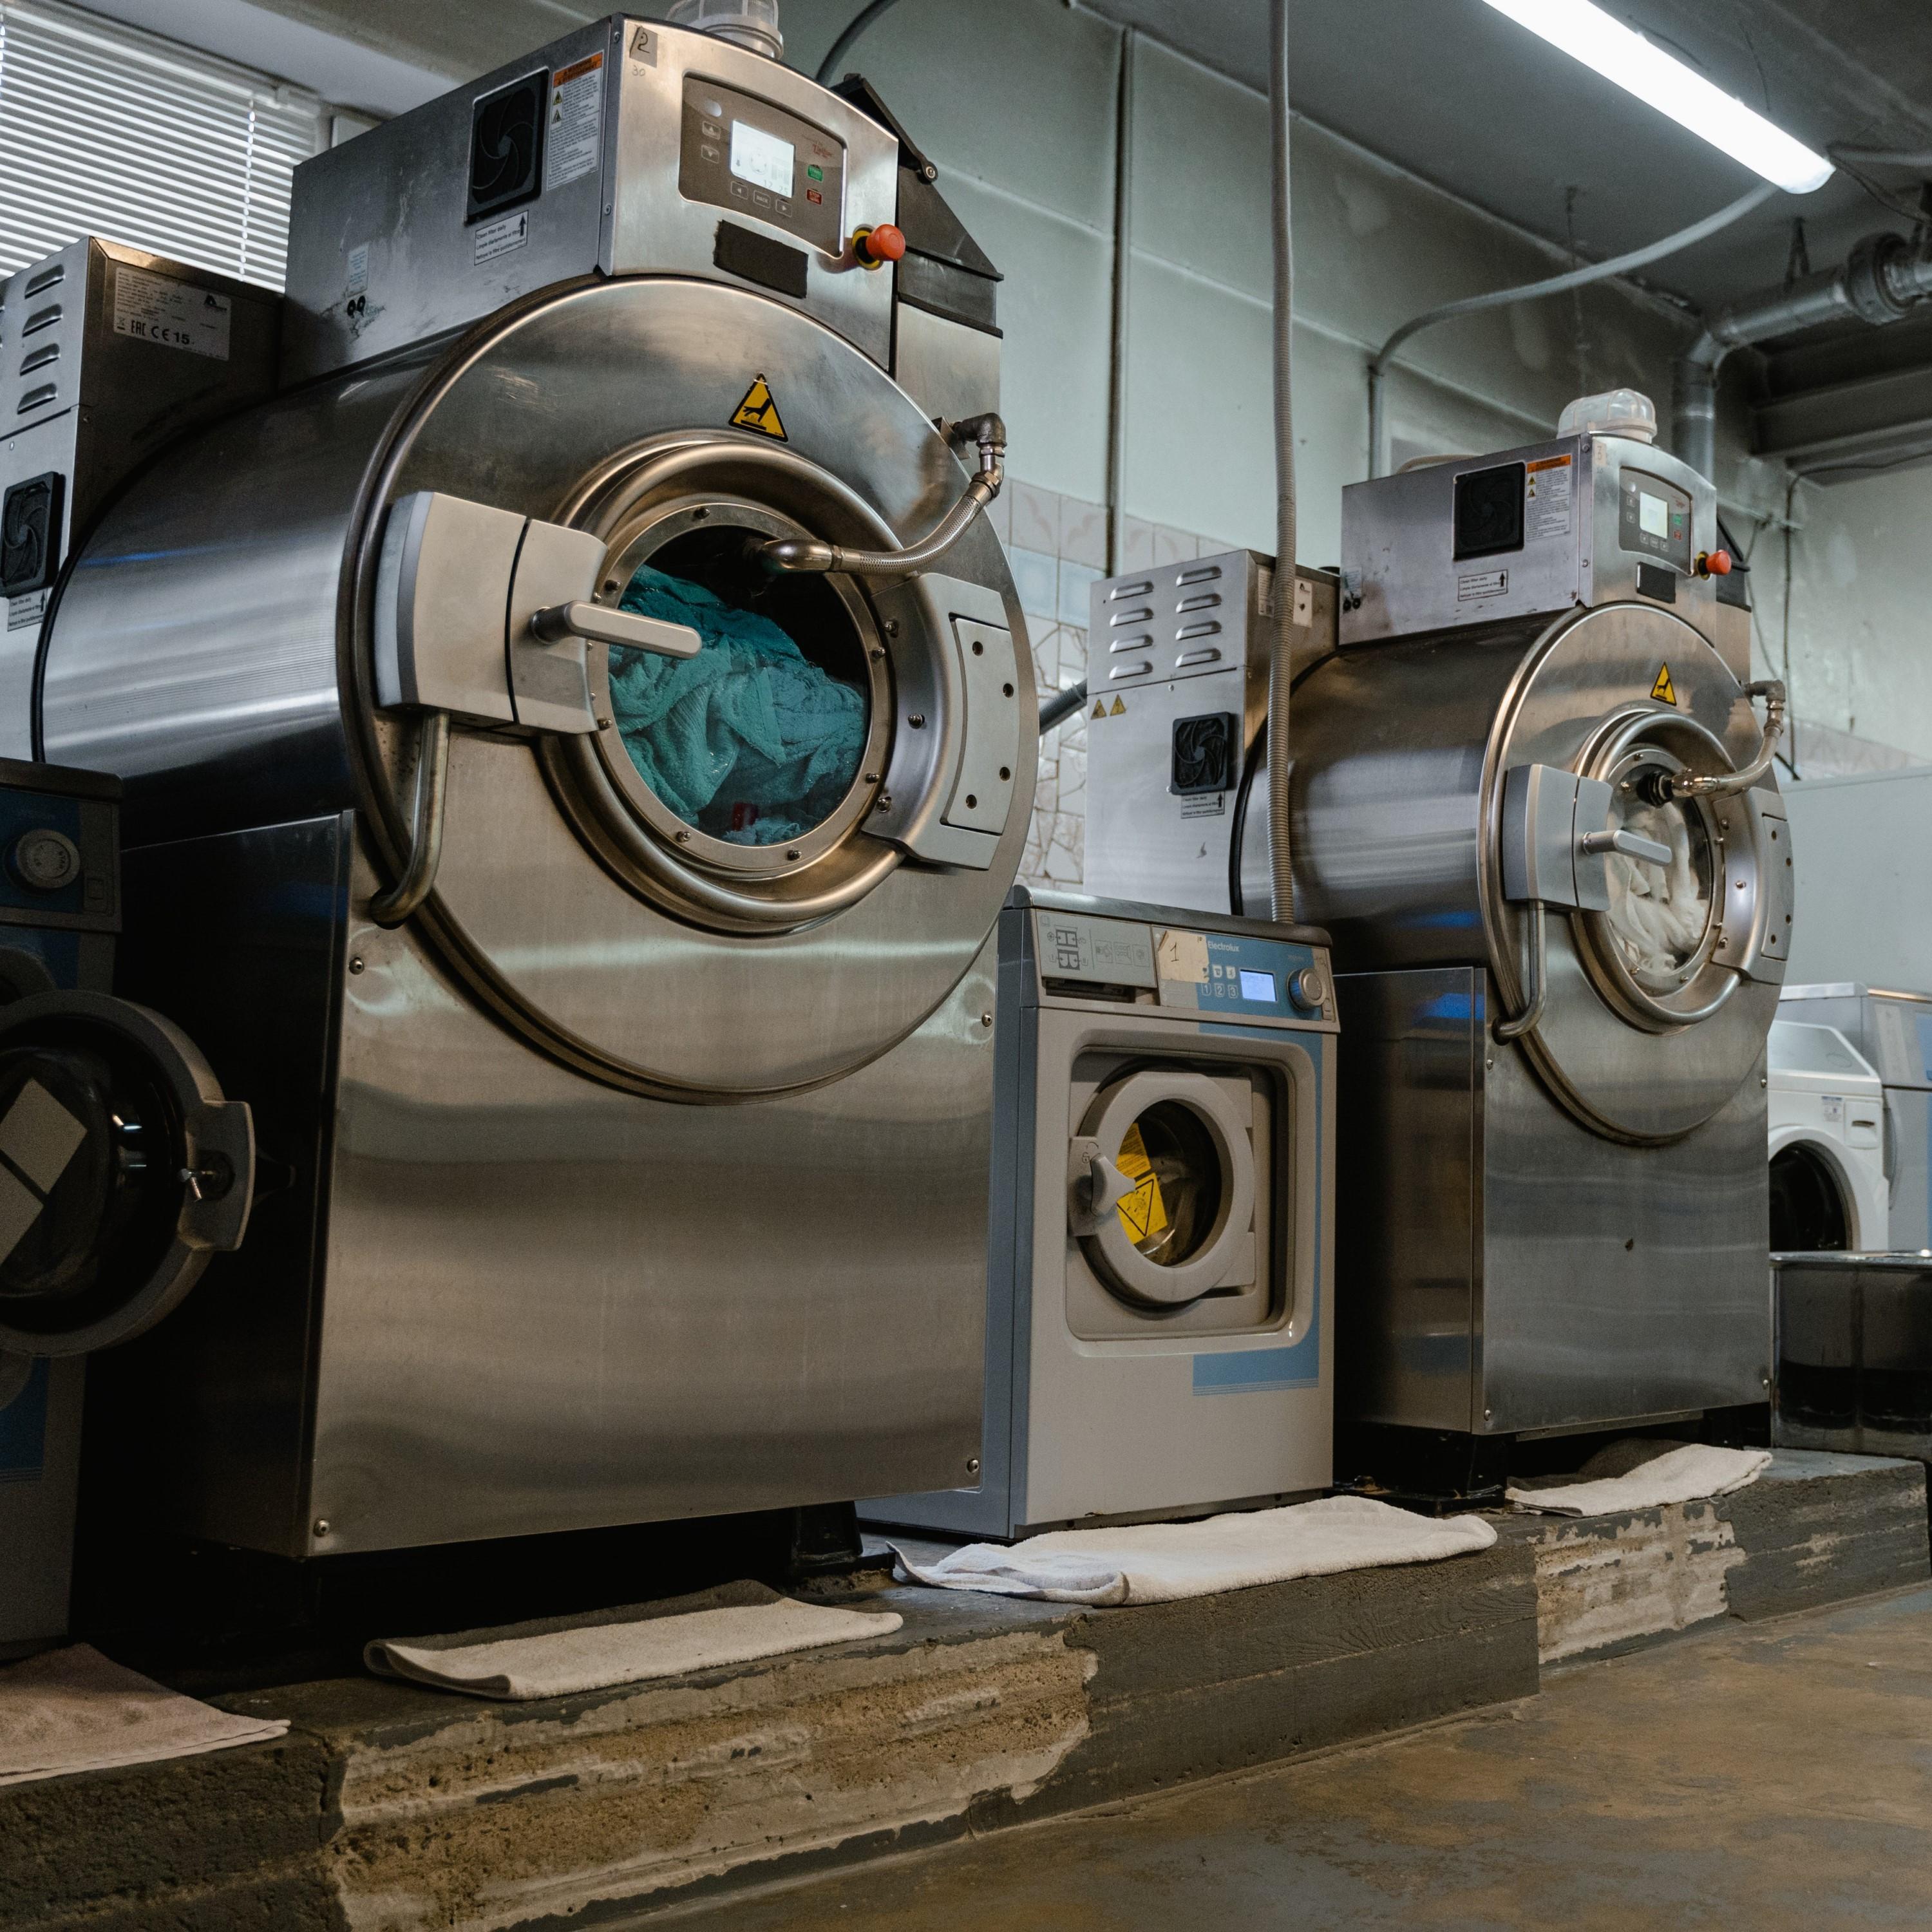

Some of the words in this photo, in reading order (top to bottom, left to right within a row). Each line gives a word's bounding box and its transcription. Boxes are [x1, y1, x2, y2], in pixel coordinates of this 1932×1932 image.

[637, 32, 650, 53] 2
[632, 64, 646, 77] 30
[151, 326, 170, 341] CE
[173, 332, 190, 345] 15
[1170, 942, 1179, 962] 1
[1208, 940, 1240, 952] Electrolux
